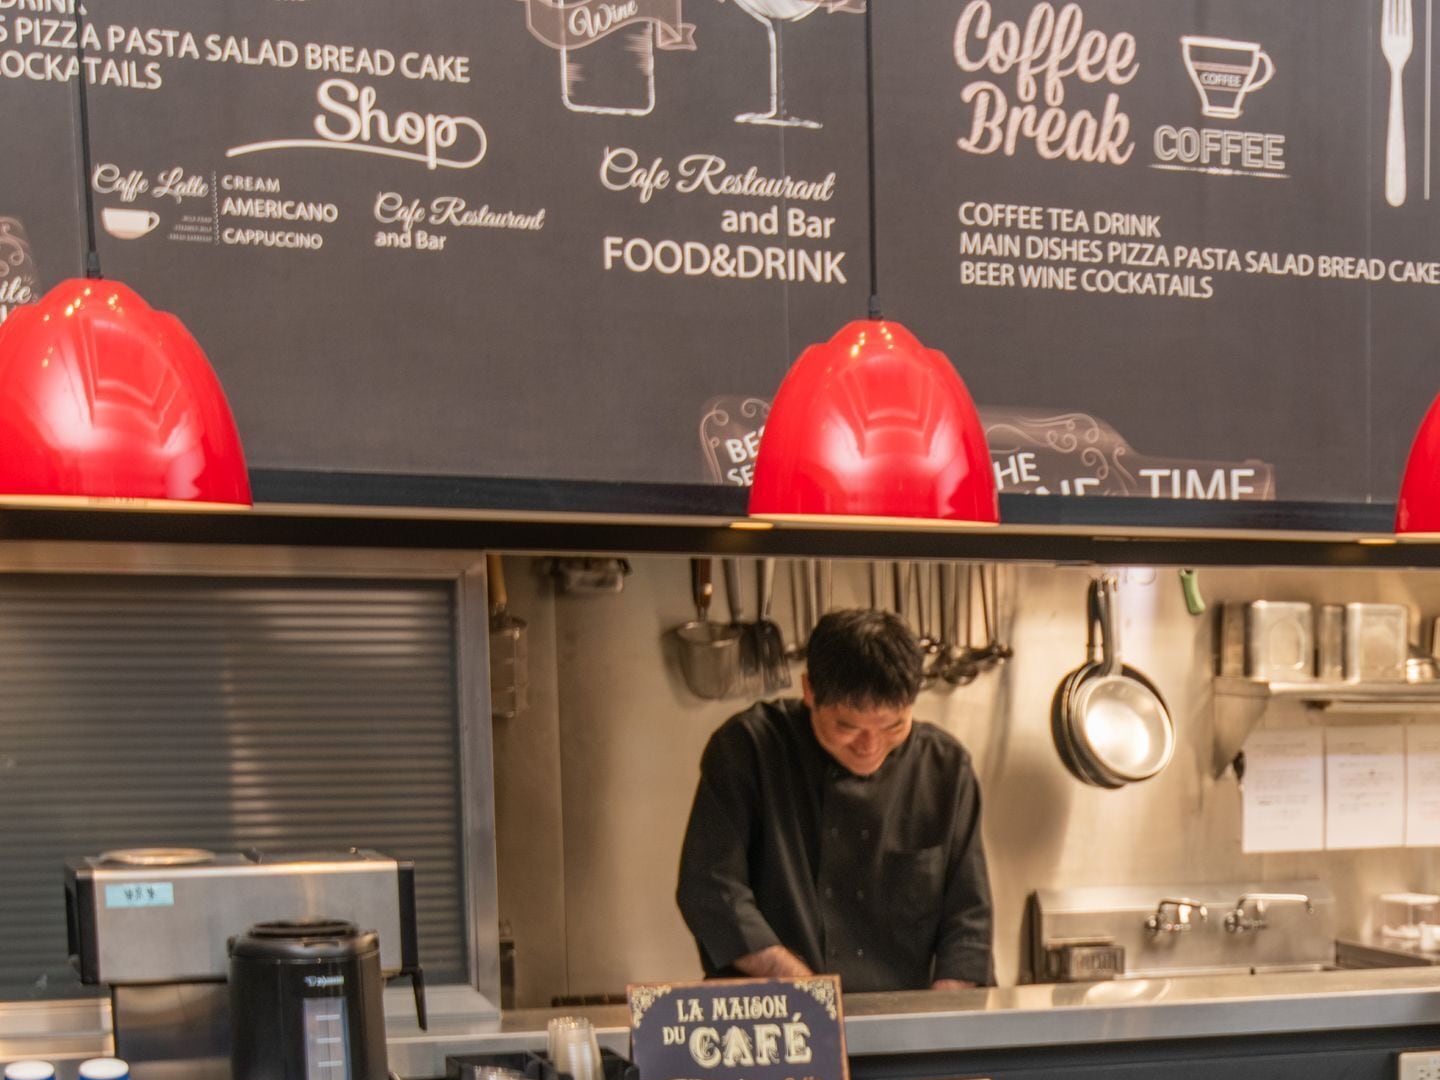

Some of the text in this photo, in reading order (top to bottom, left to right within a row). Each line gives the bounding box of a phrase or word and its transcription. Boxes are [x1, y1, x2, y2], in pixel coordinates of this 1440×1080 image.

[567, 0, 639, 38] Wine
[0, 50, 163, 91] OCKATAILS
[14, 17, 471, 84] PIZZA PASTA SALAD BREAD CAKE
[953, 0, 1141, 107] Coffee
[1200, 72, 1243, 89] COFFEE
[313, 78, 480, 168] Shop
[957, 80, 1136, 166] Break
[1152, 124, 1286, 170] COFFEE
[152, 166, 209, 204] Latte
[221, 174, 281, 193] CREAM
[600, 146, 837, 204] Cafe Restaurant
[221, 196, 338, 224] AMERICANO
[373, 191, 547, 232] Cafe Restaurant
[720, 205, 836, 239] and Bar
[958, 200, 1162, 239] COFFEE TEA DRINK
[221, 227, 323, 250] CAPPUCCINO
[374, 229, 447, 250] and Bar
[959, 231, 1020, 259] MAIN
[1024, 235, 1103, 264] DISHES
[1107, 240, 1170, 268] PIZZA
[1172, 244, 1242, 273] PASTA
[1244, 249, 1315, 278] SALAD
[1317, 255, 1386, 282] BREAD
[602, 236, 847, 285] FOOD&DRINK
[960, 260, 1214, 300] BEER WINE COCKATAILS
[676, 994, 789, 1023] LA MAISON
[662, 1011, 813, 1070] DU CAFÉ
